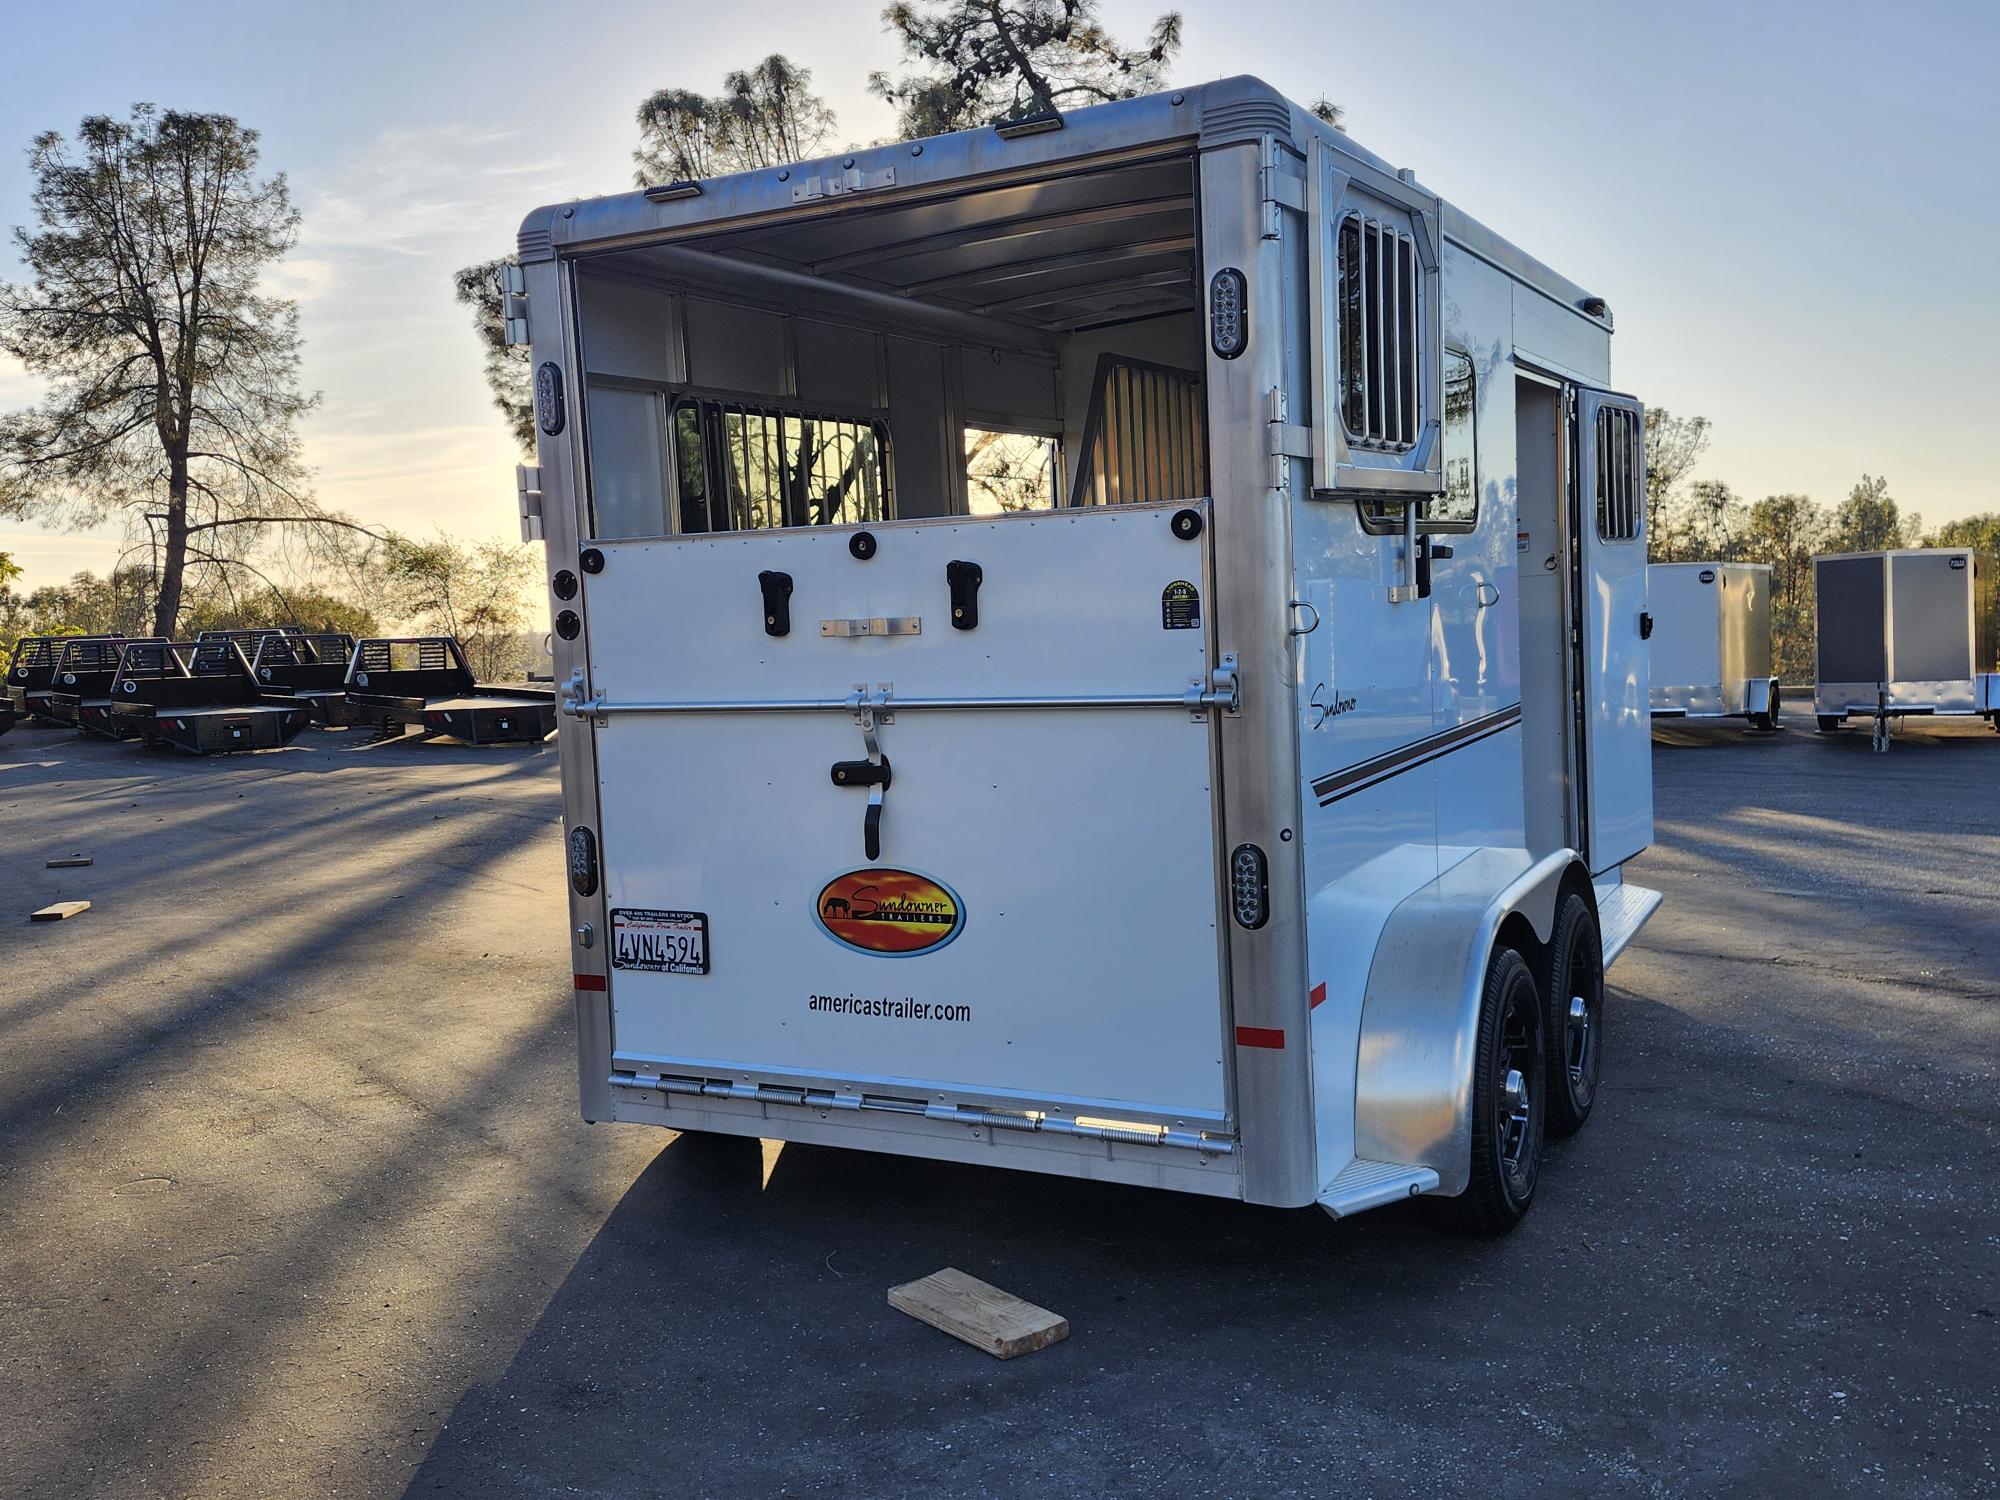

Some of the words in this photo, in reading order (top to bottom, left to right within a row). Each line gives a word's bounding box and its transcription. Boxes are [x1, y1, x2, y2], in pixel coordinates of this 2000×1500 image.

[851, 885, 948, 917] Sundowner
[881, 912, 942, 923] TRAILERS
[619, 932, 701, 964] 4VN4594
[614, 955, 661, 970] Sundowner
[661, 962, 669, 971] of
[670, 964, 704, 974] California
[808, 993, 971, 1022] americastrailer.com
